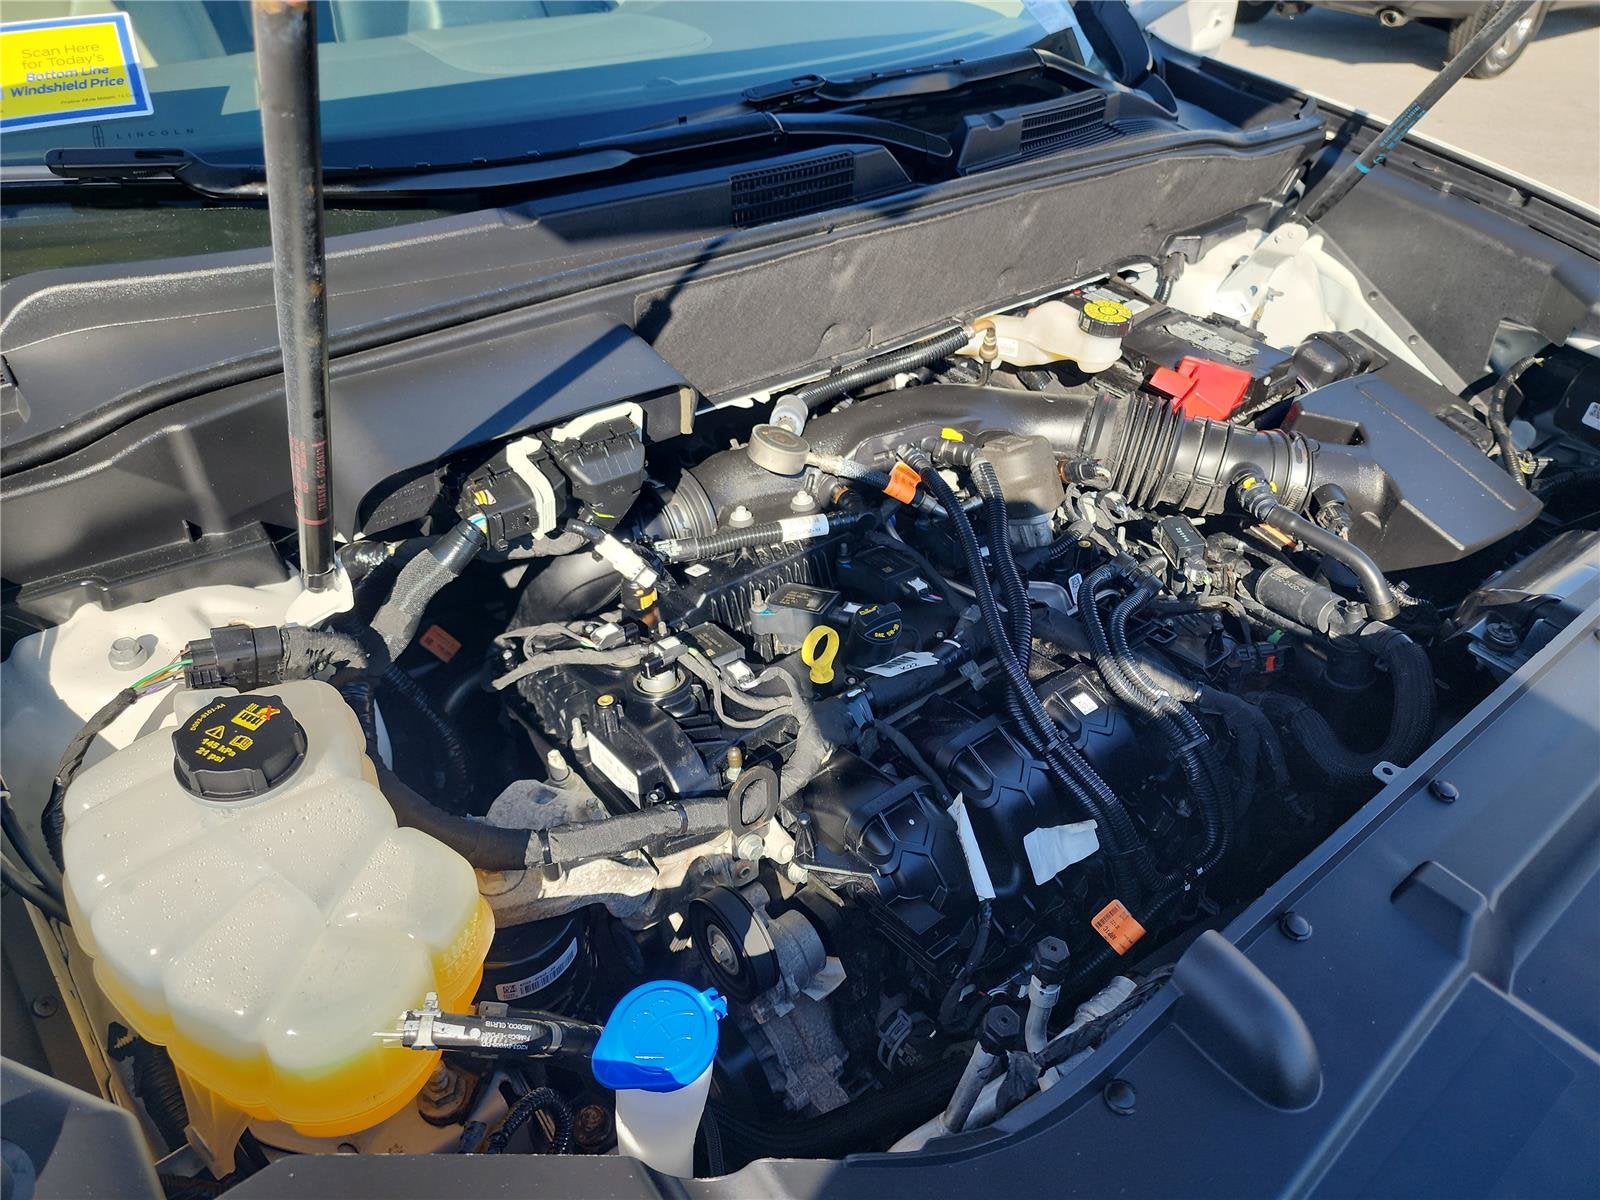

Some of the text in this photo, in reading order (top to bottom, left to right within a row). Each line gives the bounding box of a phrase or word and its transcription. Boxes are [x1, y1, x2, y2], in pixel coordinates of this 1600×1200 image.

[22, 42, 100, 59] Scan Here
[23, 53, 104, 70] for Today's
[26, 66, 110, 83] Bottom Line
[10, 76, 125, 98] Windshield Price
[116, 127, 195, 140] LINCOLN
[195, 747, 210, 757] 21
